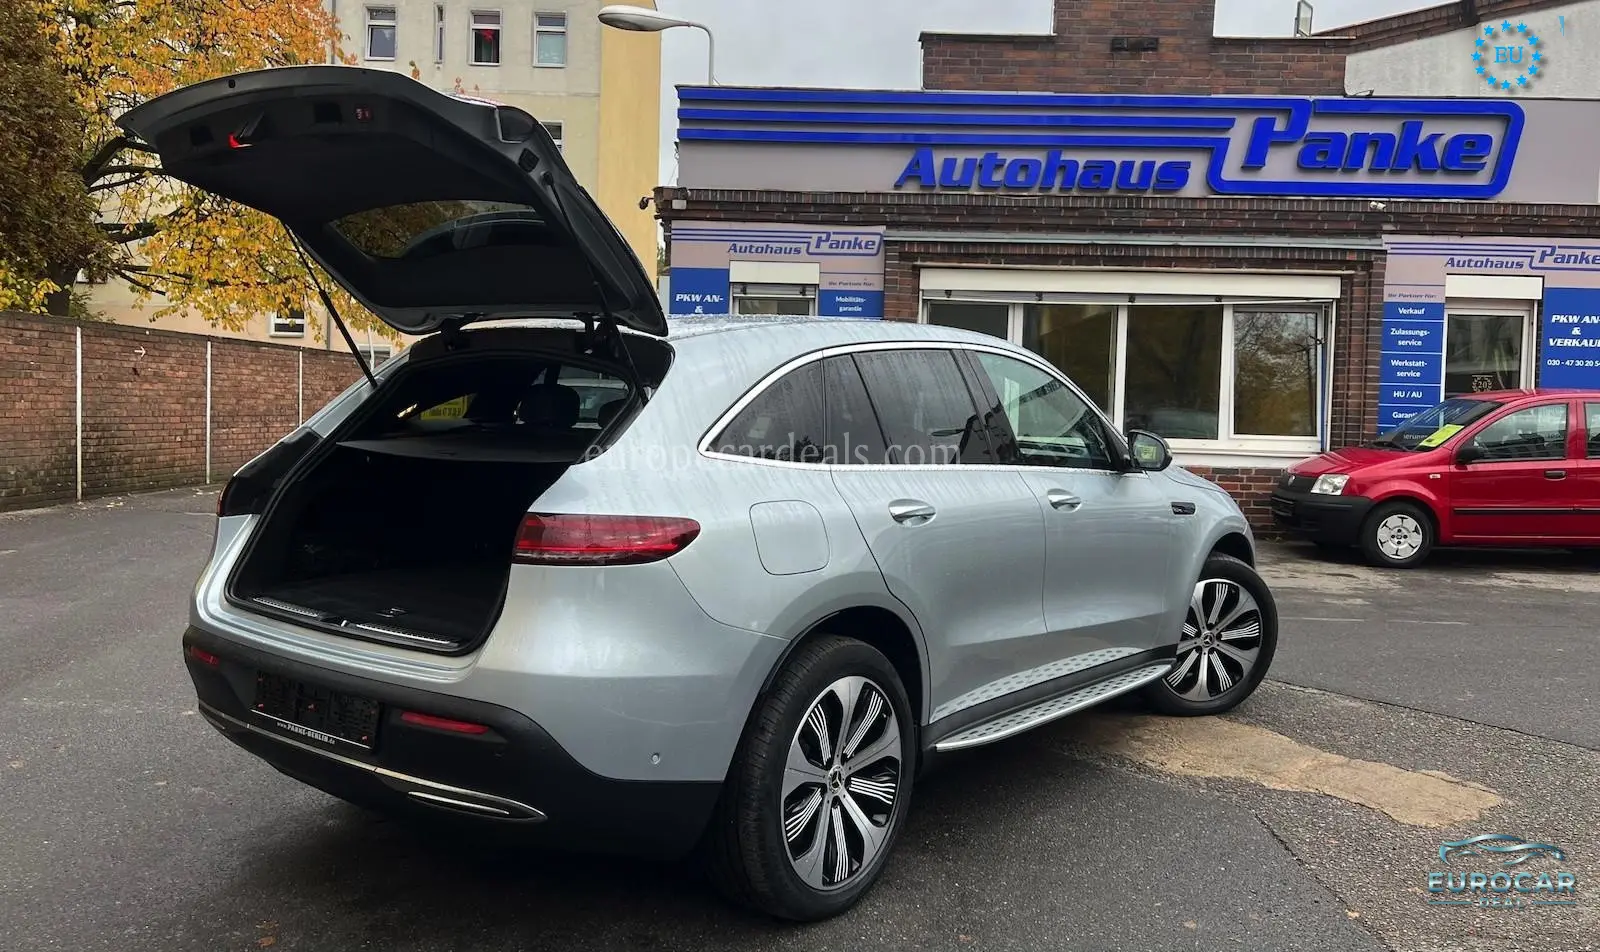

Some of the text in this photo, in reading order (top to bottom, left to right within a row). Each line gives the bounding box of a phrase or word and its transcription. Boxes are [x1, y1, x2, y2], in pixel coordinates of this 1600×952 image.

[894, 114, 1494, 192] Autohaus Panke
[728, 232, 876, 255] Autohaus Panke
[1444, 246, 1600, 269] Autohaus Panke
[675, 293, 702, 302] PKW
[694, 305, 704, 314] &
[1398, 307, 1426, 315] Verkauf
[1551, 314, 1580, 323] PKW
[1390, 327, 1431, 337] Zulassungs-
[1571, 326, 1582, 336] &
[1390, 359, 1428, 367] Werkstatt-
[1546, 358, 1560, 366] 030
[1575, 359, 1584, 367] 30
[1393, 390, 1405, 398] HU
[1411, 391, 1423, 399] AU
